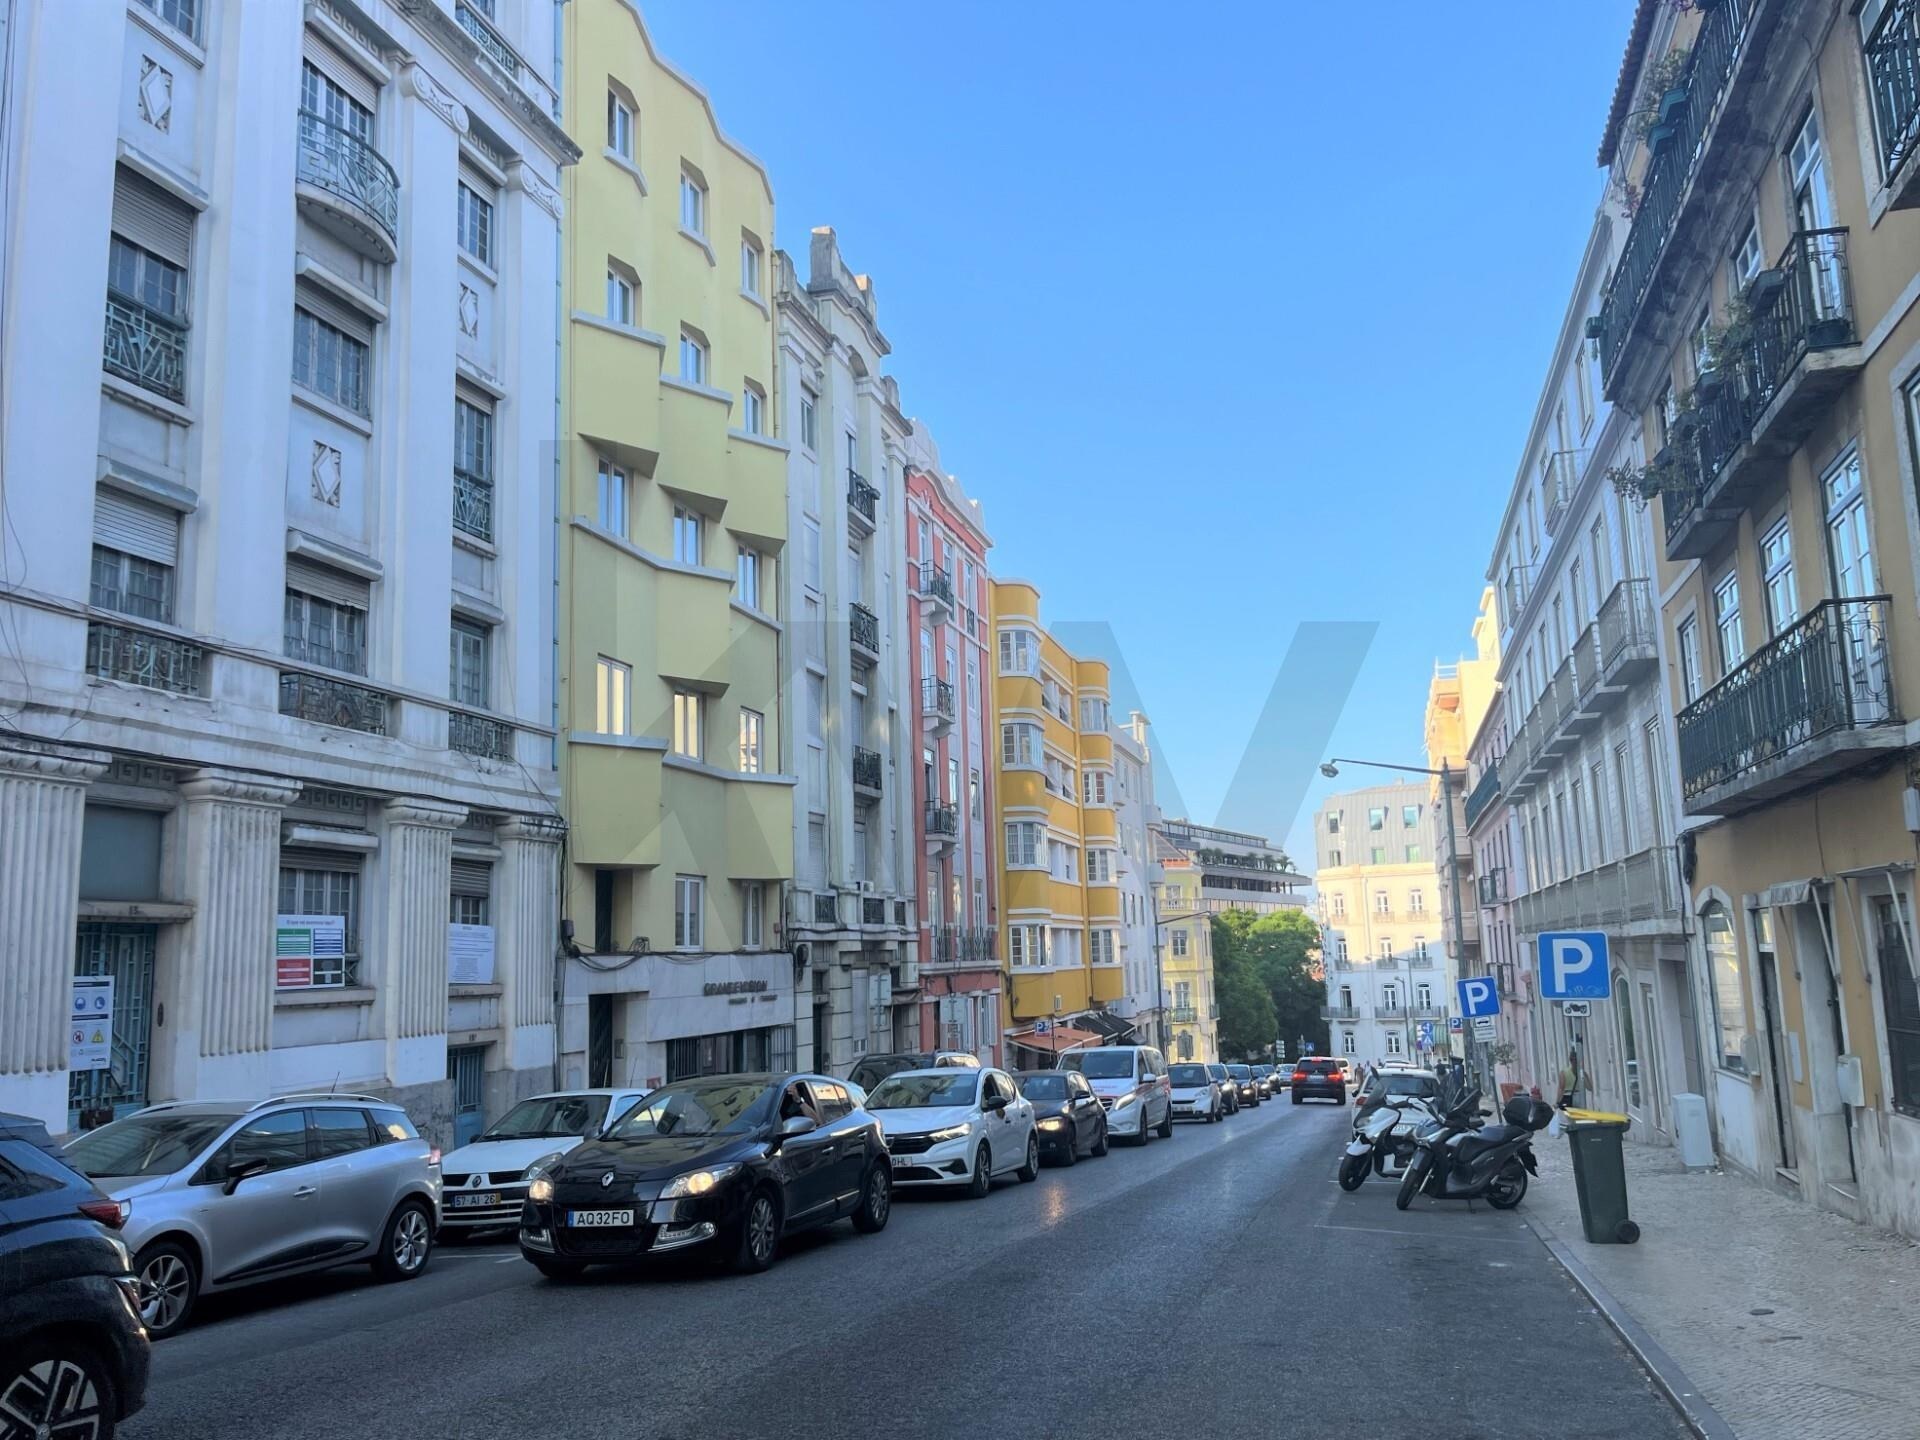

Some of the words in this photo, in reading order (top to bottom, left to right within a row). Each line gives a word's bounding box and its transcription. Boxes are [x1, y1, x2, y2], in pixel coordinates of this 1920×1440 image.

[1552, 938, 1593, 993] P
[1465, 982, 1489, 1015] P
[577, 1211, 630, 1225] AQ32FO
